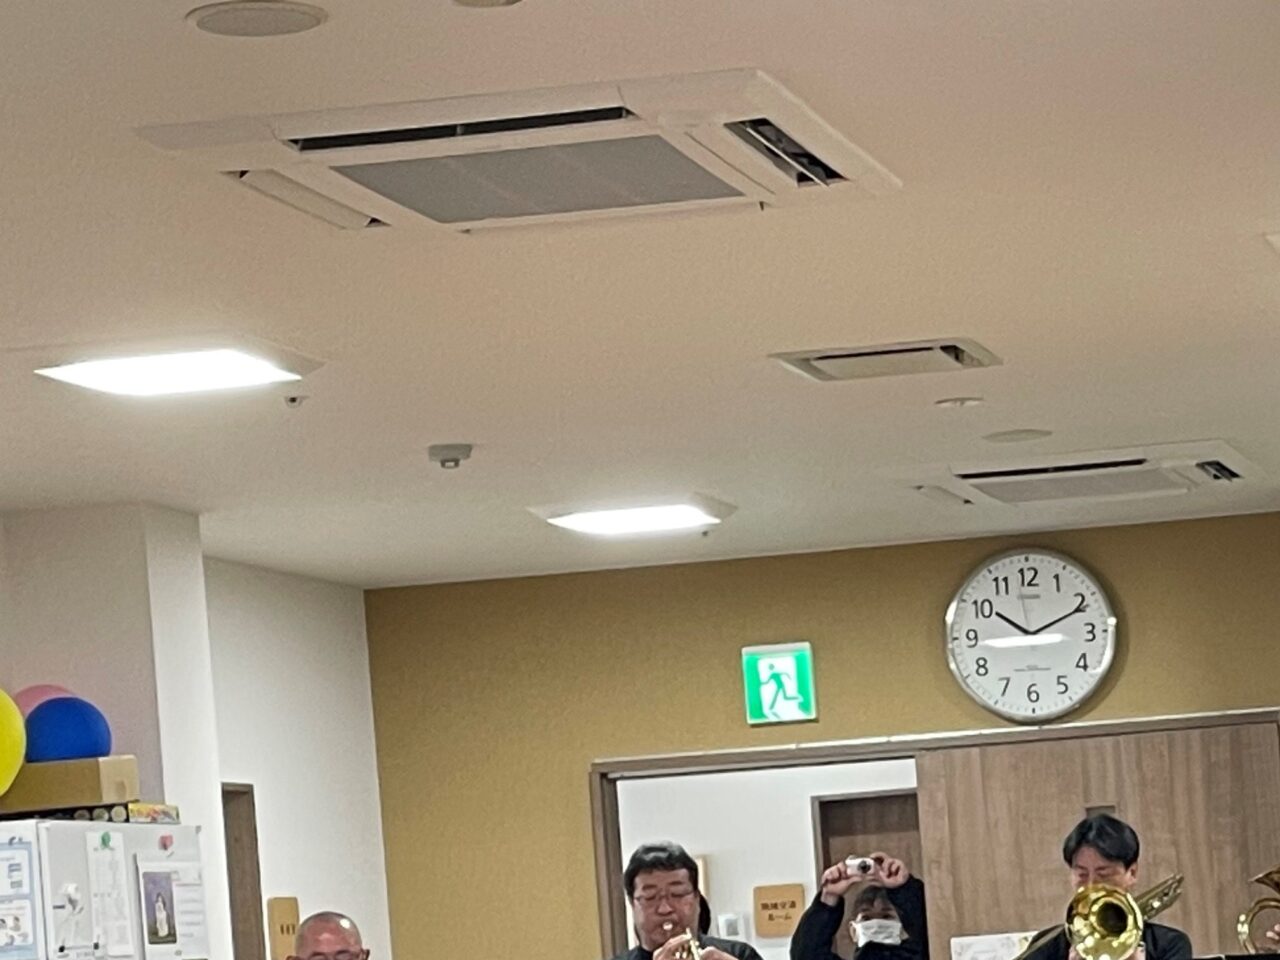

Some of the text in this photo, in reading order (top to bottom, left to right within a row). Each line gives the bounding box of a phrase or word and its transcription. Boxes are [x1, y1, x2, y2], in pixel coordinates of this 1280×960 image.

[992, 576, 1010, 596] 11
[1017, 566, 1040, 588] 12
[1053, 573, 1061, 593] 1
[972, 598, 994, 619] 10
[1073, 592, 1088, 613] 2
[965, 628, 979, 649] 9
[1083, 622, 1097, 642] 3
[975, 656, 989, 677] 8
[1075, 652, 1089, 673] 4
[998, 677, 1011, 697] 7
[1026, 683, 1040, 703] 6
[1056, 675, 1069, 695] 5
